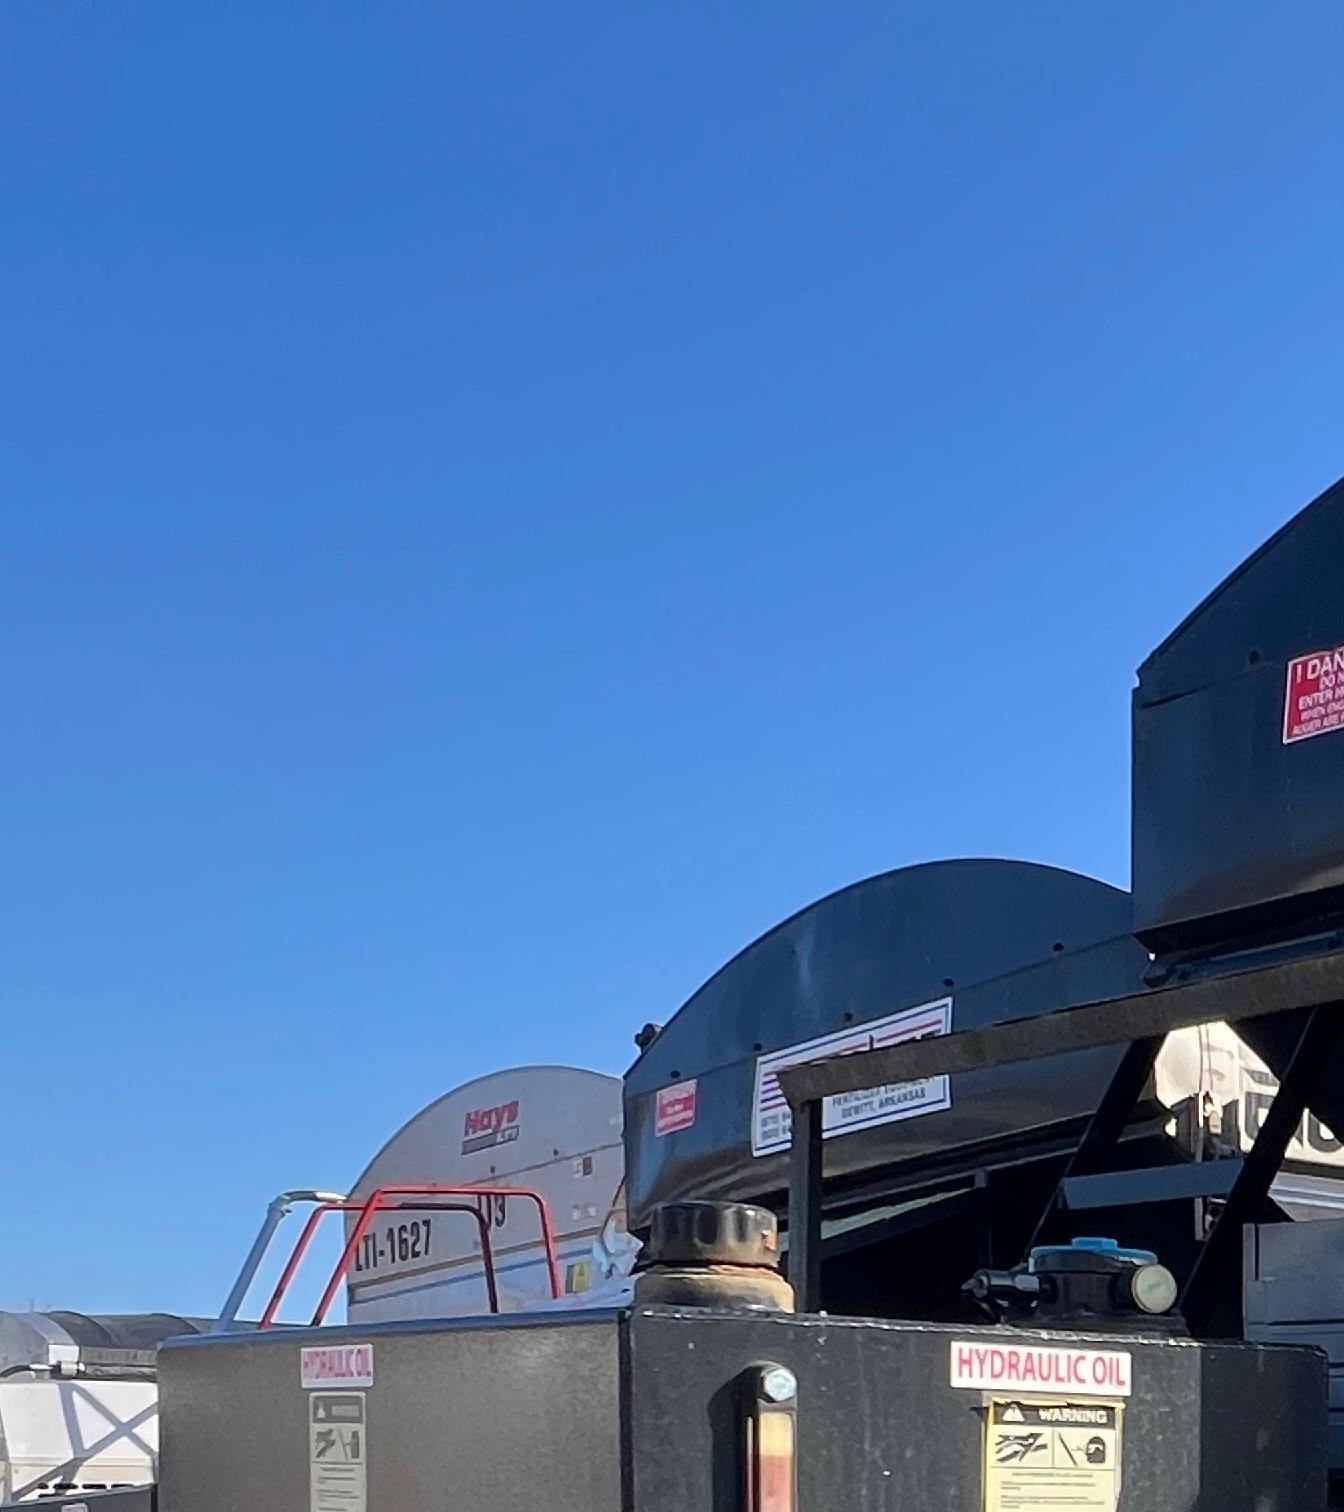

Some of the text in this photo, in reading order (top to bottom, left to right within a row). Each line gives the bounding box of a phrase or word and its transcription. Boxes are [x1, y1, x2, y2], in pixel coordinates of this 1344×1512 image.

[957, 1347, 1126, 1387] HYDRAULIC OIL
[1038, 1407, 1108, 1424] WARNING
